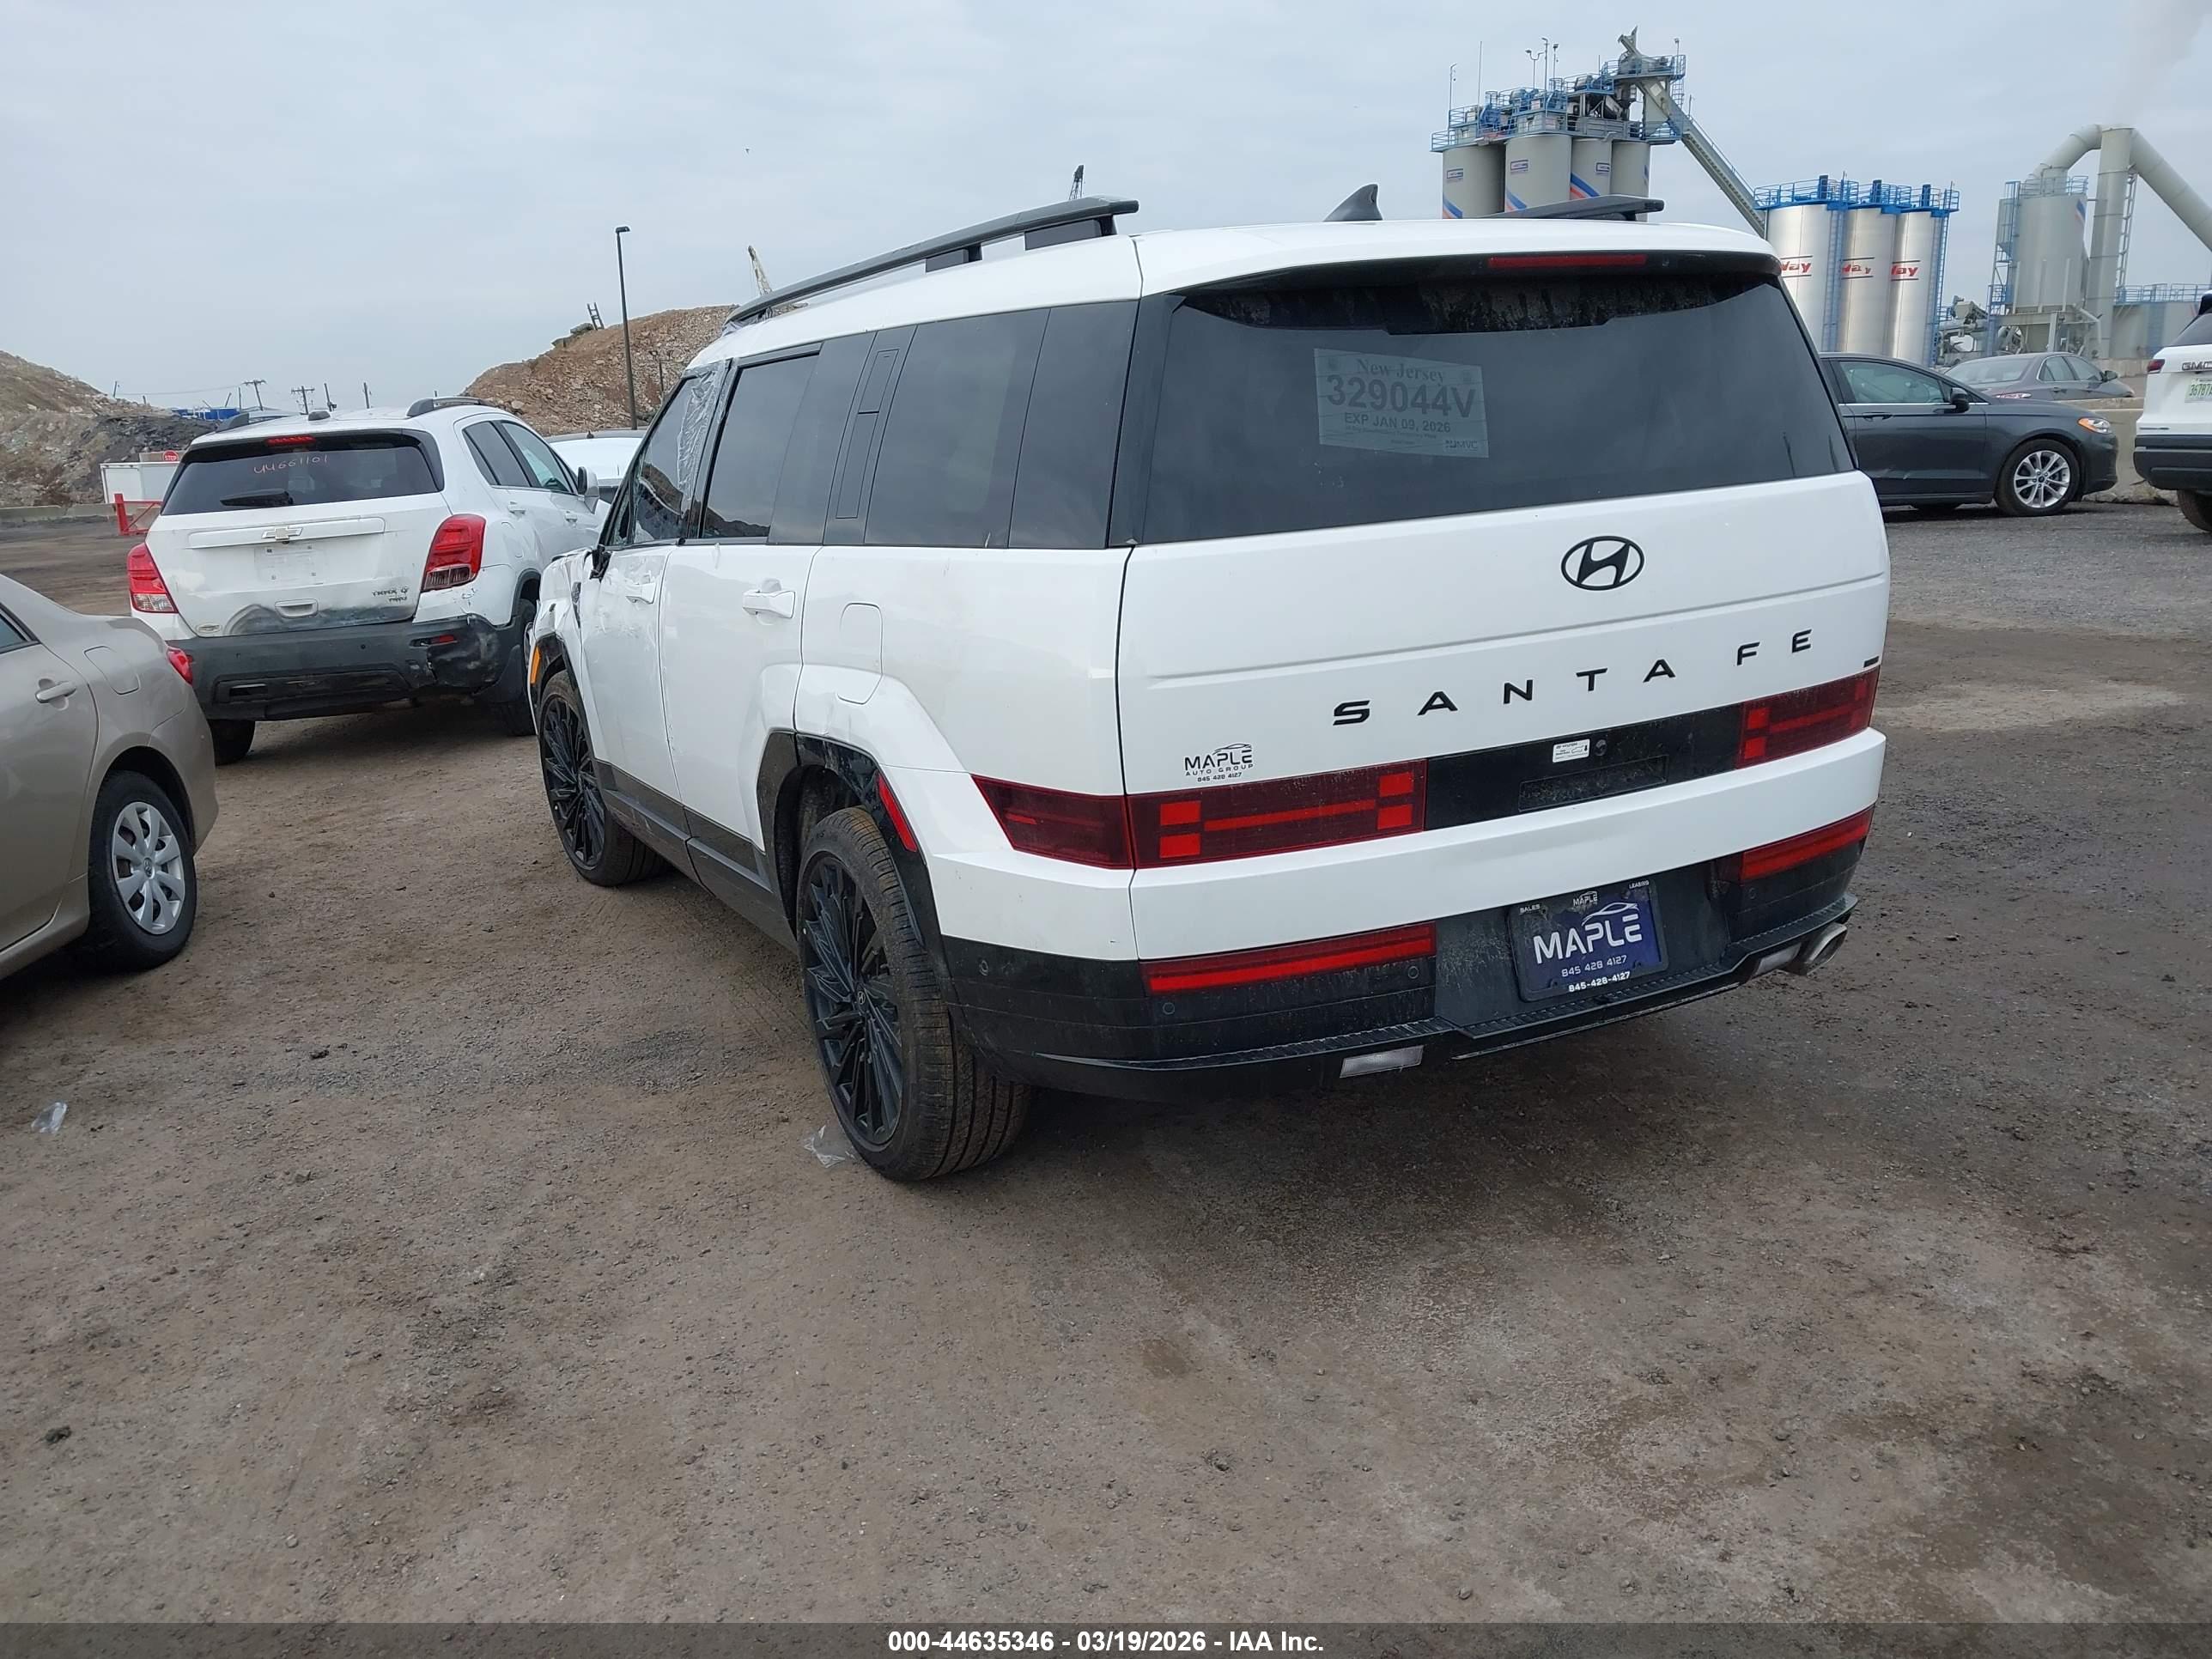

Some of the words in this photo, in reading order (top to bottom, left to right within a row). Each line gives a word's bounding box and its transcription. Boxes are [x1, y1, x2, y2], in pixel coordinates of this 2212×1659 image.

[1357, 359, 1389, 375] New
[1396, 363, 1446, 385] Jersey
[1328, 374, 1476, 418] 329044V
[1345, 412, 1369, 425] EXP
[1374, 416, 1397, 429] JAN
[1423, 420, 1451, 433] 2026
[1333, 659, 1676, 726] SANTA
[1736, 629, 1813, 666] FE
[1185, 750, 1252, 770] MAPLE
[1218, 764, 1254, 773] GROUP
[1519, 903, 1540, 914] SALES
[1573, 892, 1598, 907] MAPLE
[1533, 914, 1643, 964] MAPLE
[1561, 966, 1581, 977] 845
[1584, 962, 1603, 971] 428
[1607, 955, 1627, 966] 4127
[1568, 971, 1631, 993] 845-428-4127
